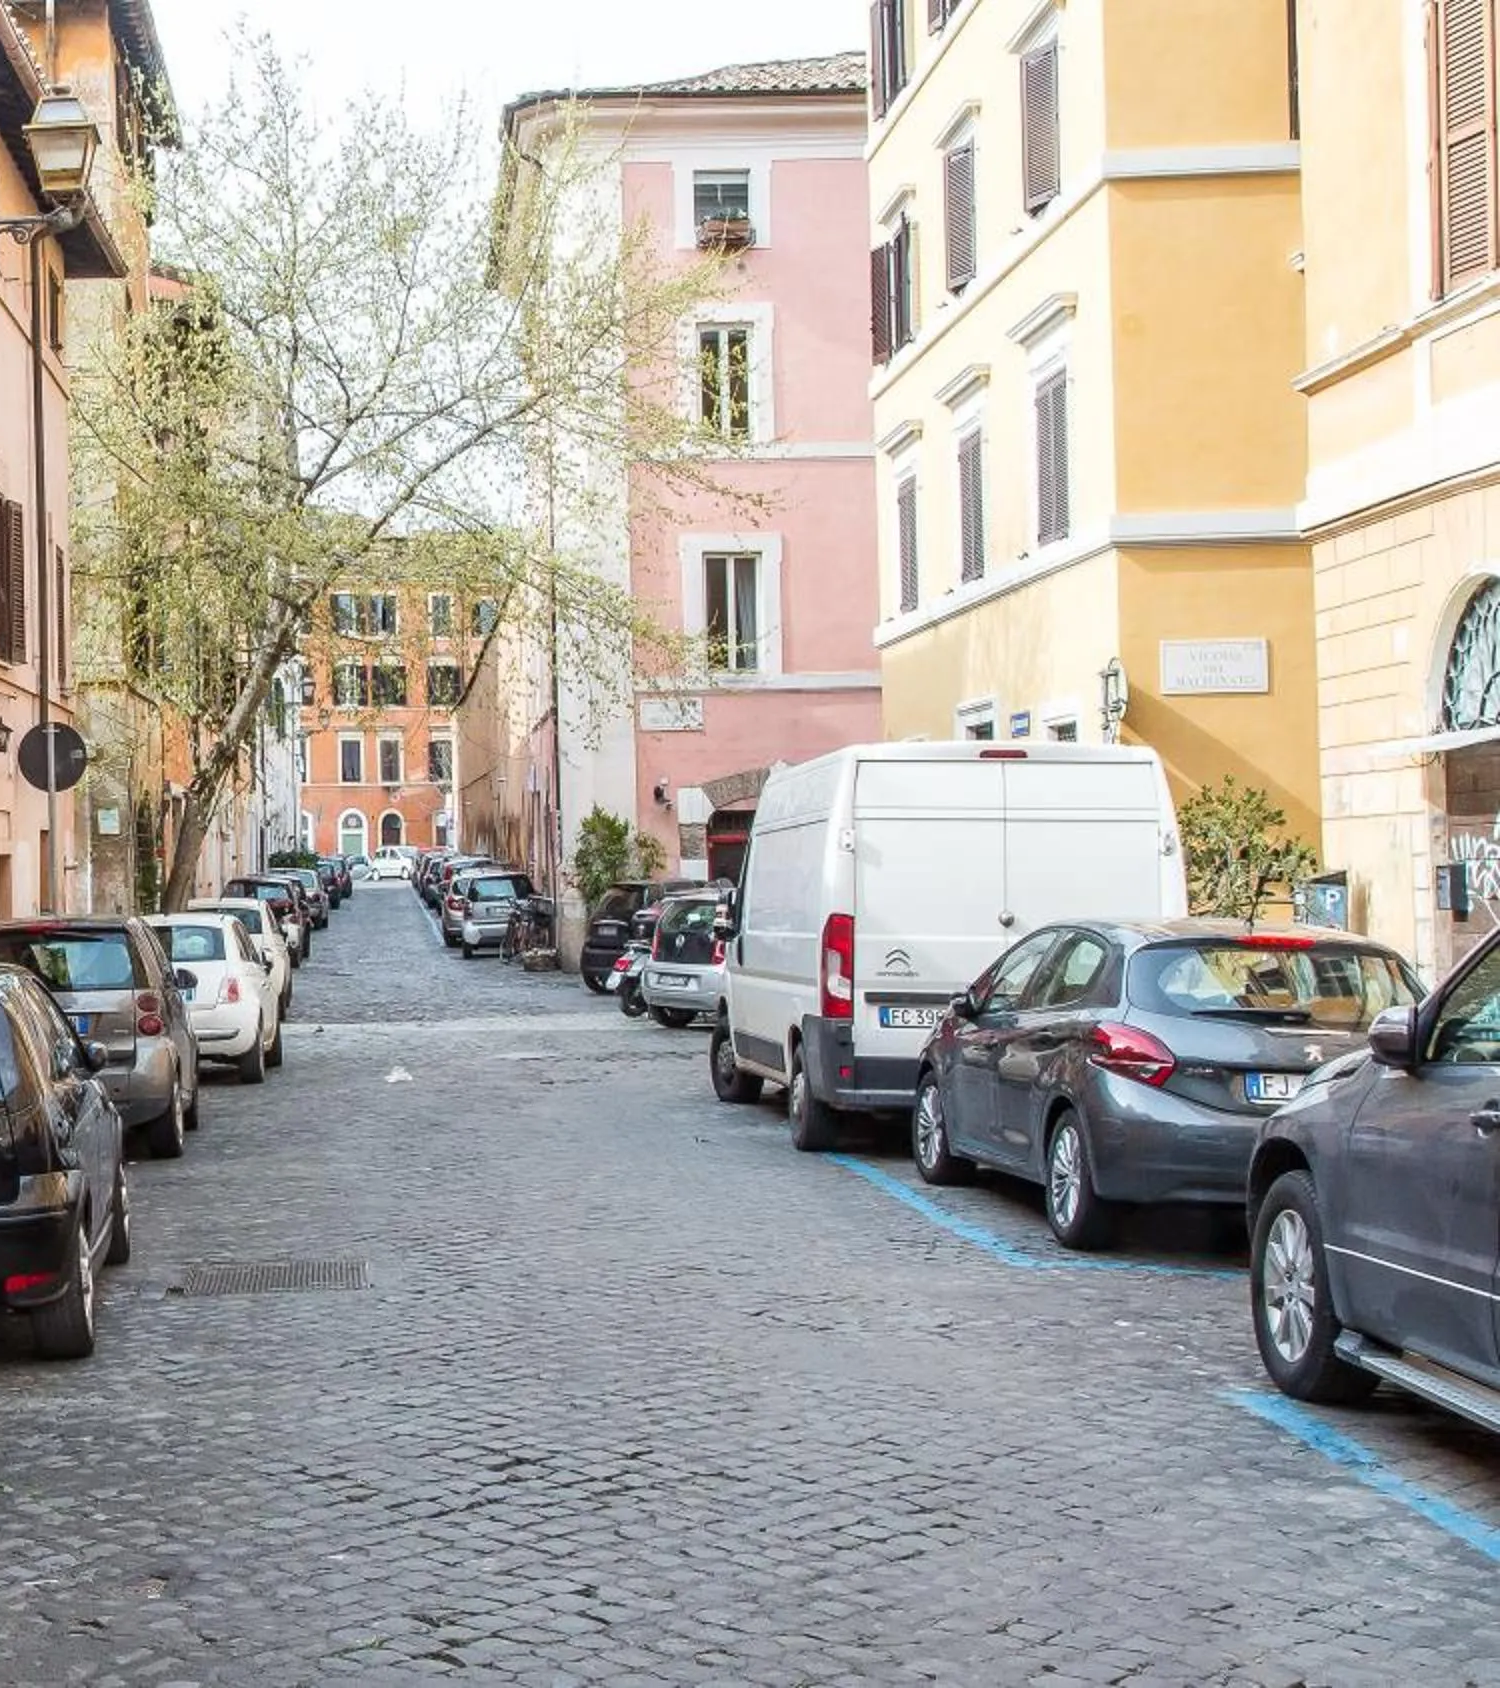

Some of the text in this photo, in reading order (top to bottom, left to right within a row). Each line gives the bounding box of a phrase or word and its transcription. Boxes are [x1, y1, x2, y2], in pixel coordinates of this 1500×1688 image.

[1326, 889, 1340, 910] P
[891, 1009, 910, 1025] FC
[1263, 1074, 1289, 1097] FJ
